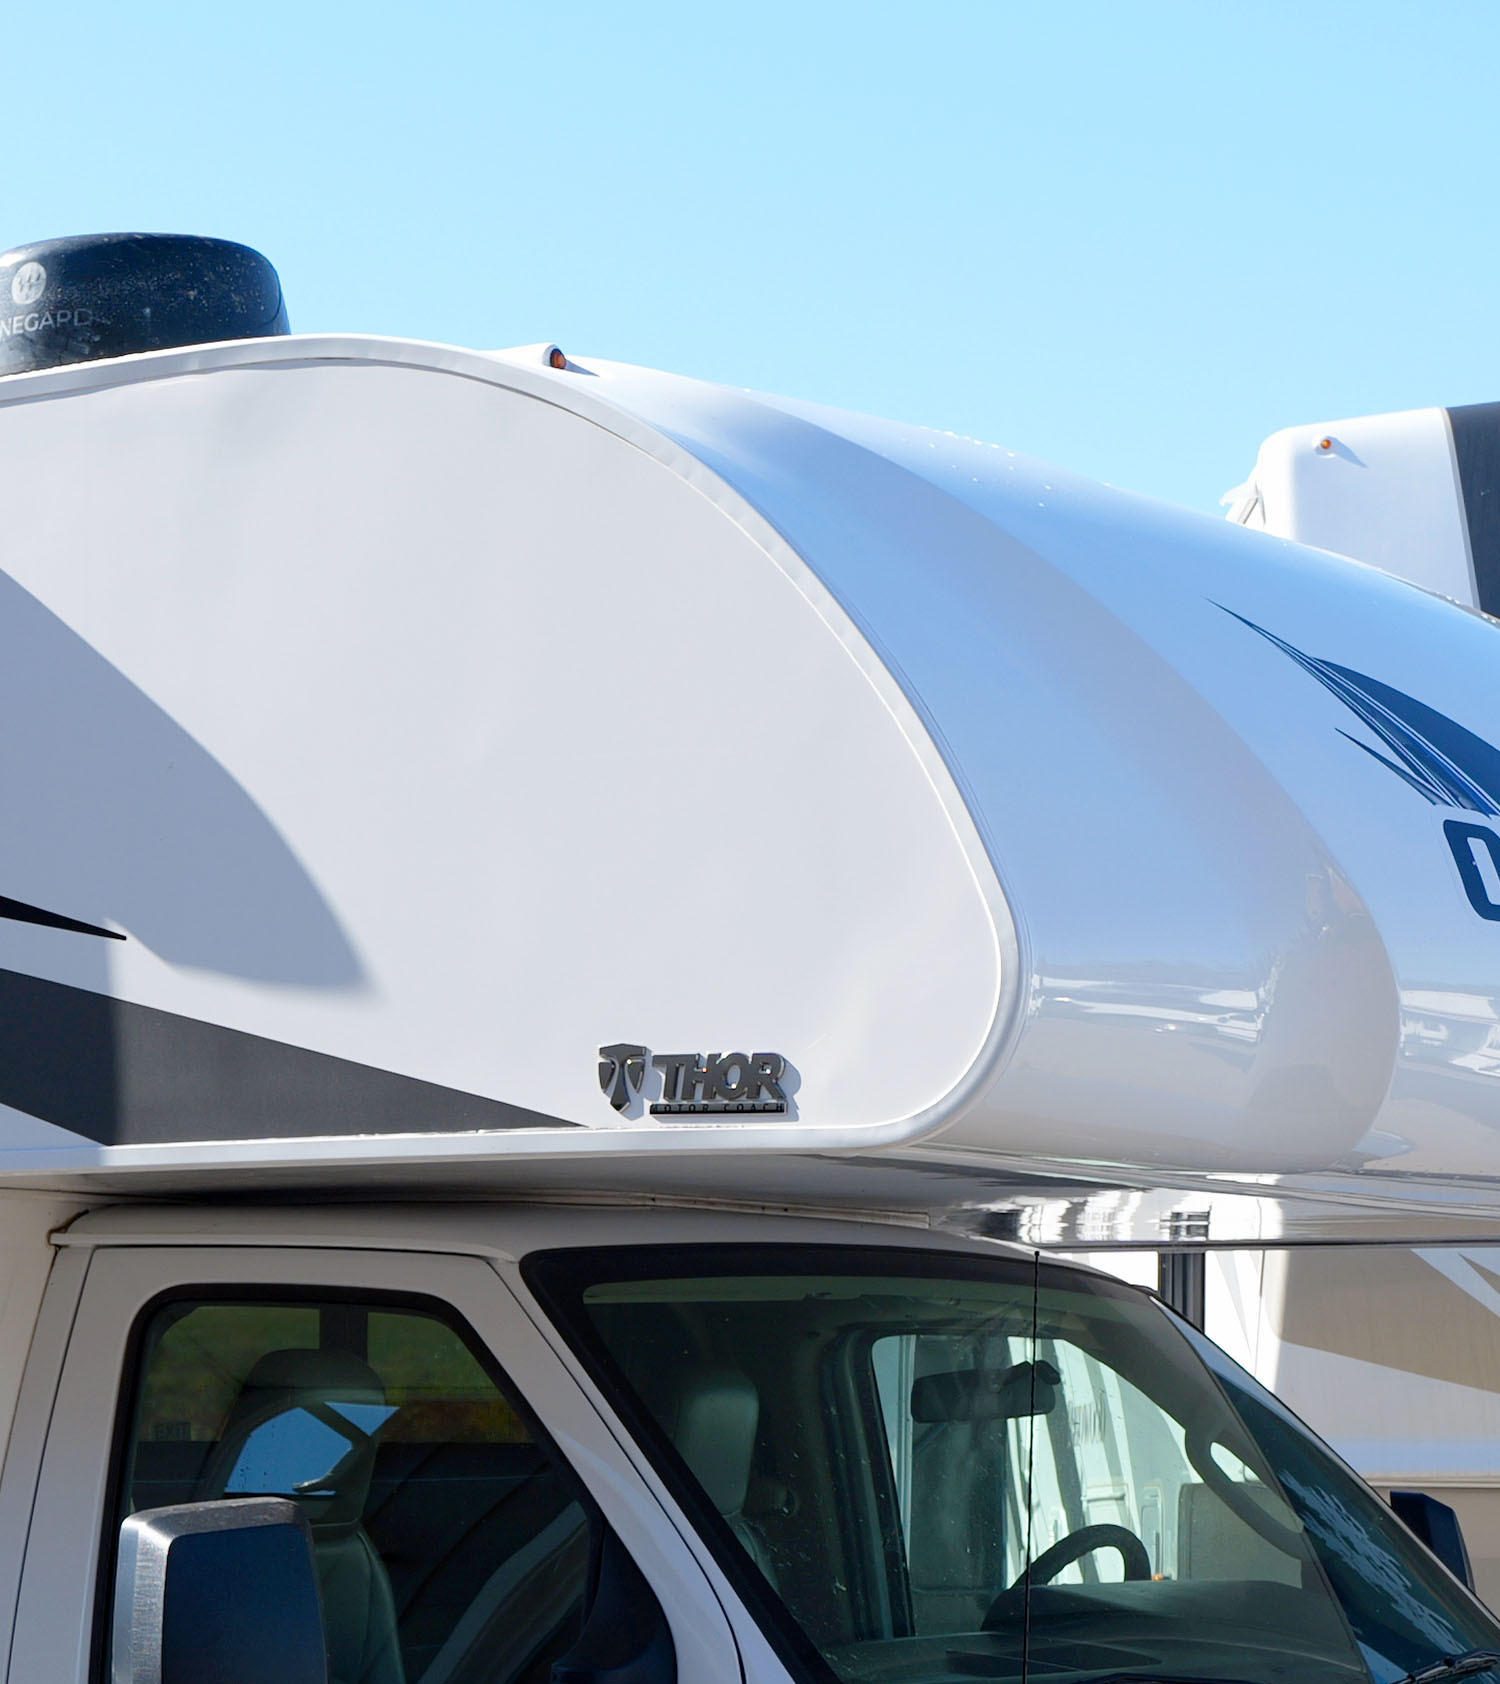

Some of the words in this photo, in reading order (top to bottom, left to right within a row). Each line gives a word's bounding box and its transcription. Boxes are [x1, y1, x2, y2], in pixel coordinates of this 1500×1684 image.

[652, 1052, 788, 1102] THOR
[651, 1103, 710, 1113] MOTOR
[723, 1103, 785, 1112] COACH
